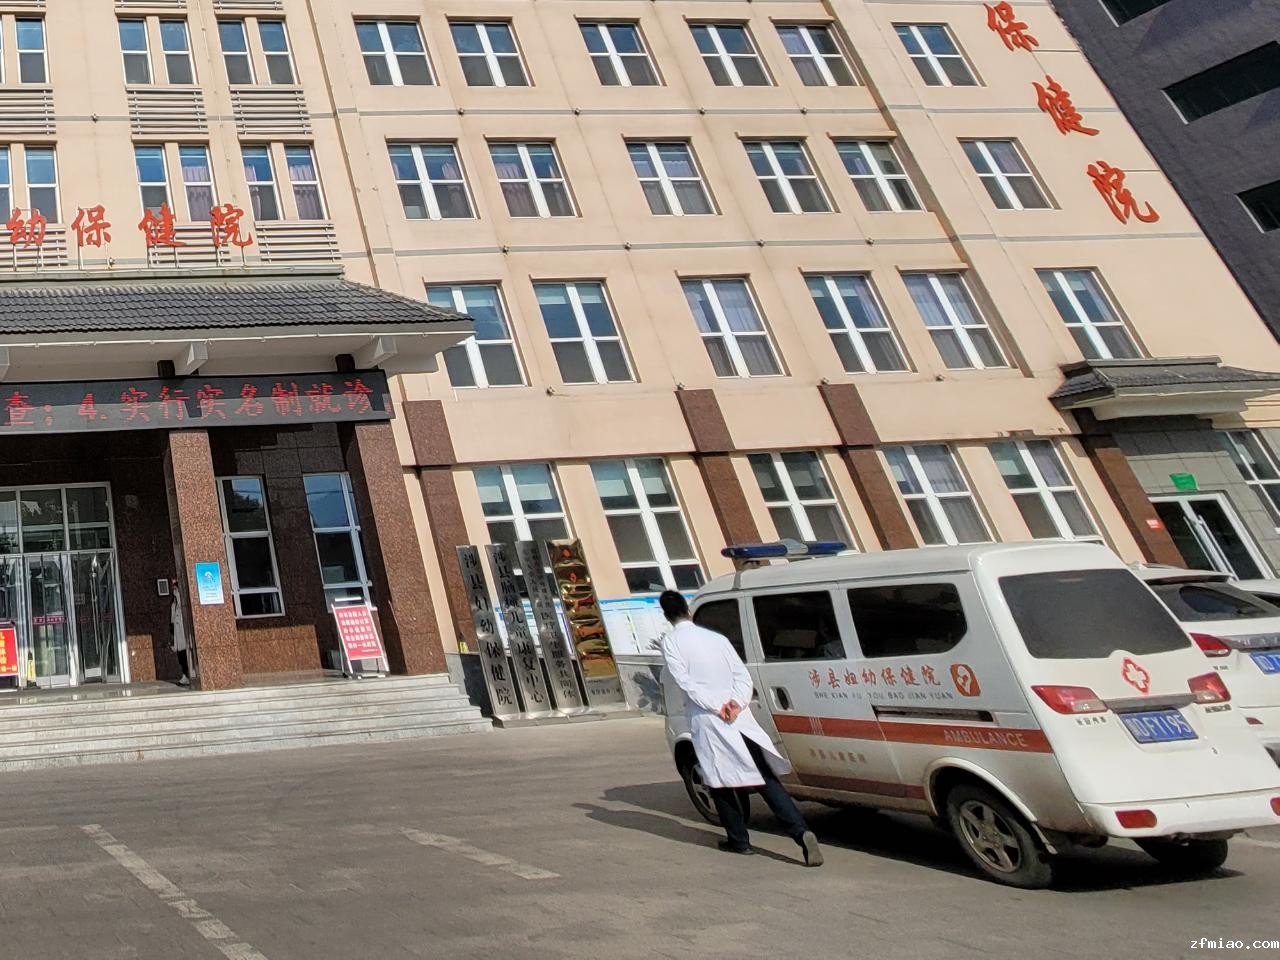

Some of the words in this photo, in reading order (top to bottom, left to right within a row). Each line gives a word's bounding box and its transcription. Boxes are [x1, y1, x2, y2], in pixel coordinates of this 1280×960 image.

[464, 552, 513, 706] 涉县妇幼保健院
[808, 663, 941, 690] 涉县妇幼保健院
[831, 692, 849, 700] XIAN
[867, 692, 885, 700] YOU
[888, 692, 904, 700] BAO
[930, 692, 954, 700] YUAN
[943, 729, 1028, 747] AMBULANCE
